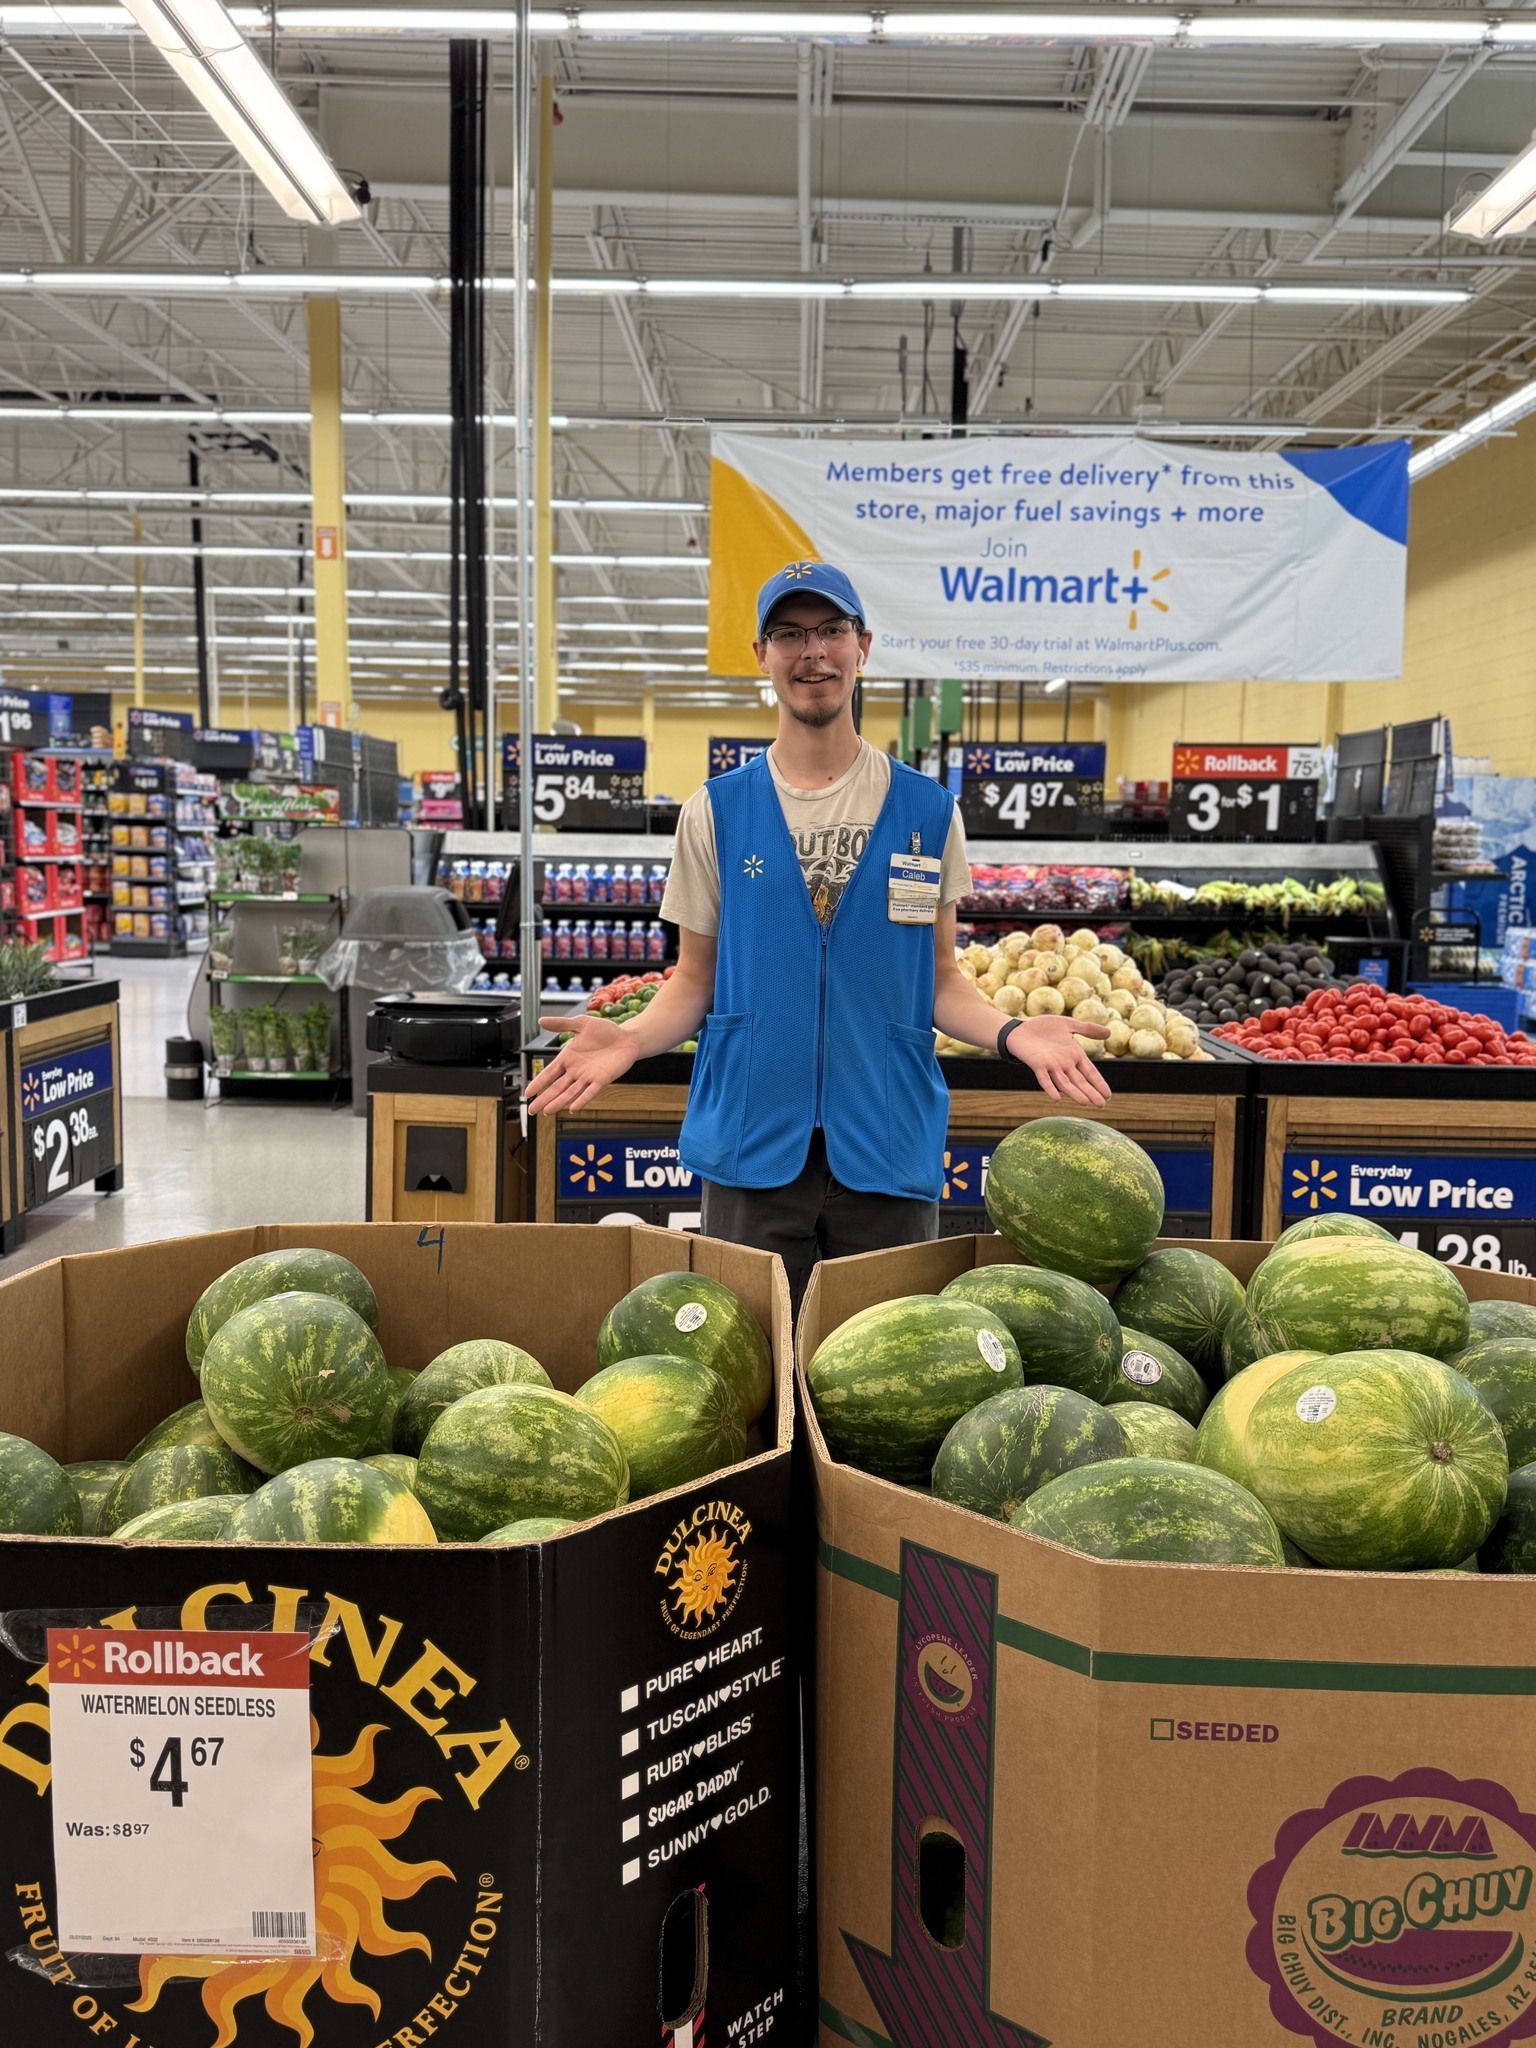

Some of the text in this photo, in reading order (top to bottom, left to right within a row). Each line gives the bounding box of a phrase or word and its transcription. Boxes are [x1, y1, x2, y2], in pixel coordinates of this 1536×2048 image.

[827, 461, 942, 484] Members
[951, 465, 992, 490] get
[1001, 463, 1051, 484] free
[1181, 465, 1240, 488] from
[1249, 473, 1294, 490] this
[856, 499, 1264, 528] store, major fuel savings + more
[980, 537, 1027, 558] Join
[882, 634, 1222, 653] Start your free 30-day trial at WalmartPlus.com.
[983, 661, 1038, 672] minimum.
[1044, 662, 1113, 674] Restrictions
[535, 750, 614, 766] Low Price
[995, 756, 1074, 772] Low Price
[1204, 755, 1277, 772] Rollback
[1187, 783, 1220, 832] 3
[902, 860, 921, 868] Walmart
[902, 870, 926, 881] Caleb
[1508, 855, 1528, 924] ARCTIC
[42, 1067, 62, 1081] Everyday
[43, 1068, 94, 1104] Low Price
[626, 1160, 693, 1188] Low
[1351, 1164, 1412, 1180] Everyday
[1350, 1178, 1514, 1210] Low Price
[417, 1226, 445, 1274] 4
[654, 1501, 753, 1577] DULCINEA
[660, 1599, 672, 1625] FRUIT
[671, 1624, 680, 1634] OF
[680, 1620, 720, 1640] LEGENDARY
[104, 1640, 264, 1676] Rollback
[646, 1627, 763, 1698] PURE HEART
[916, 1634, 978, 1680] LYCOPENE LEADER
[81, 1694, 275, 1718] WATERMELON SEEDLESS
[647, 1690, 718, 1740] TUSCAN
[1176, 1721, 1280, 1743] SEEDED
[648, 1716, 752, 1785] RUBY BLISS
[648, 1763, 740, 1827] SUGAR DADDY
[66, 1822, 110, 1837] Was:
[648, 1786, 770, 1868] SUNNY GOLD
[1308, 1865, 1533, 1952] BIG CHUY
[1277, 1914, 1296, 1944] BIG
[16, 1882, 118, 2036] FRUIT OF
[1280, 1952, 1316, 1994] CHUY
[727, 1988, 784, 2038] WATCH
[1506, 1984, 1530, 2010] AZ
[738, 2016, 774, 2048] STEP
[1381, 2005, 1464, 2027] BRAND
[1418, 2010, 1509, 2048] NOGALES,
